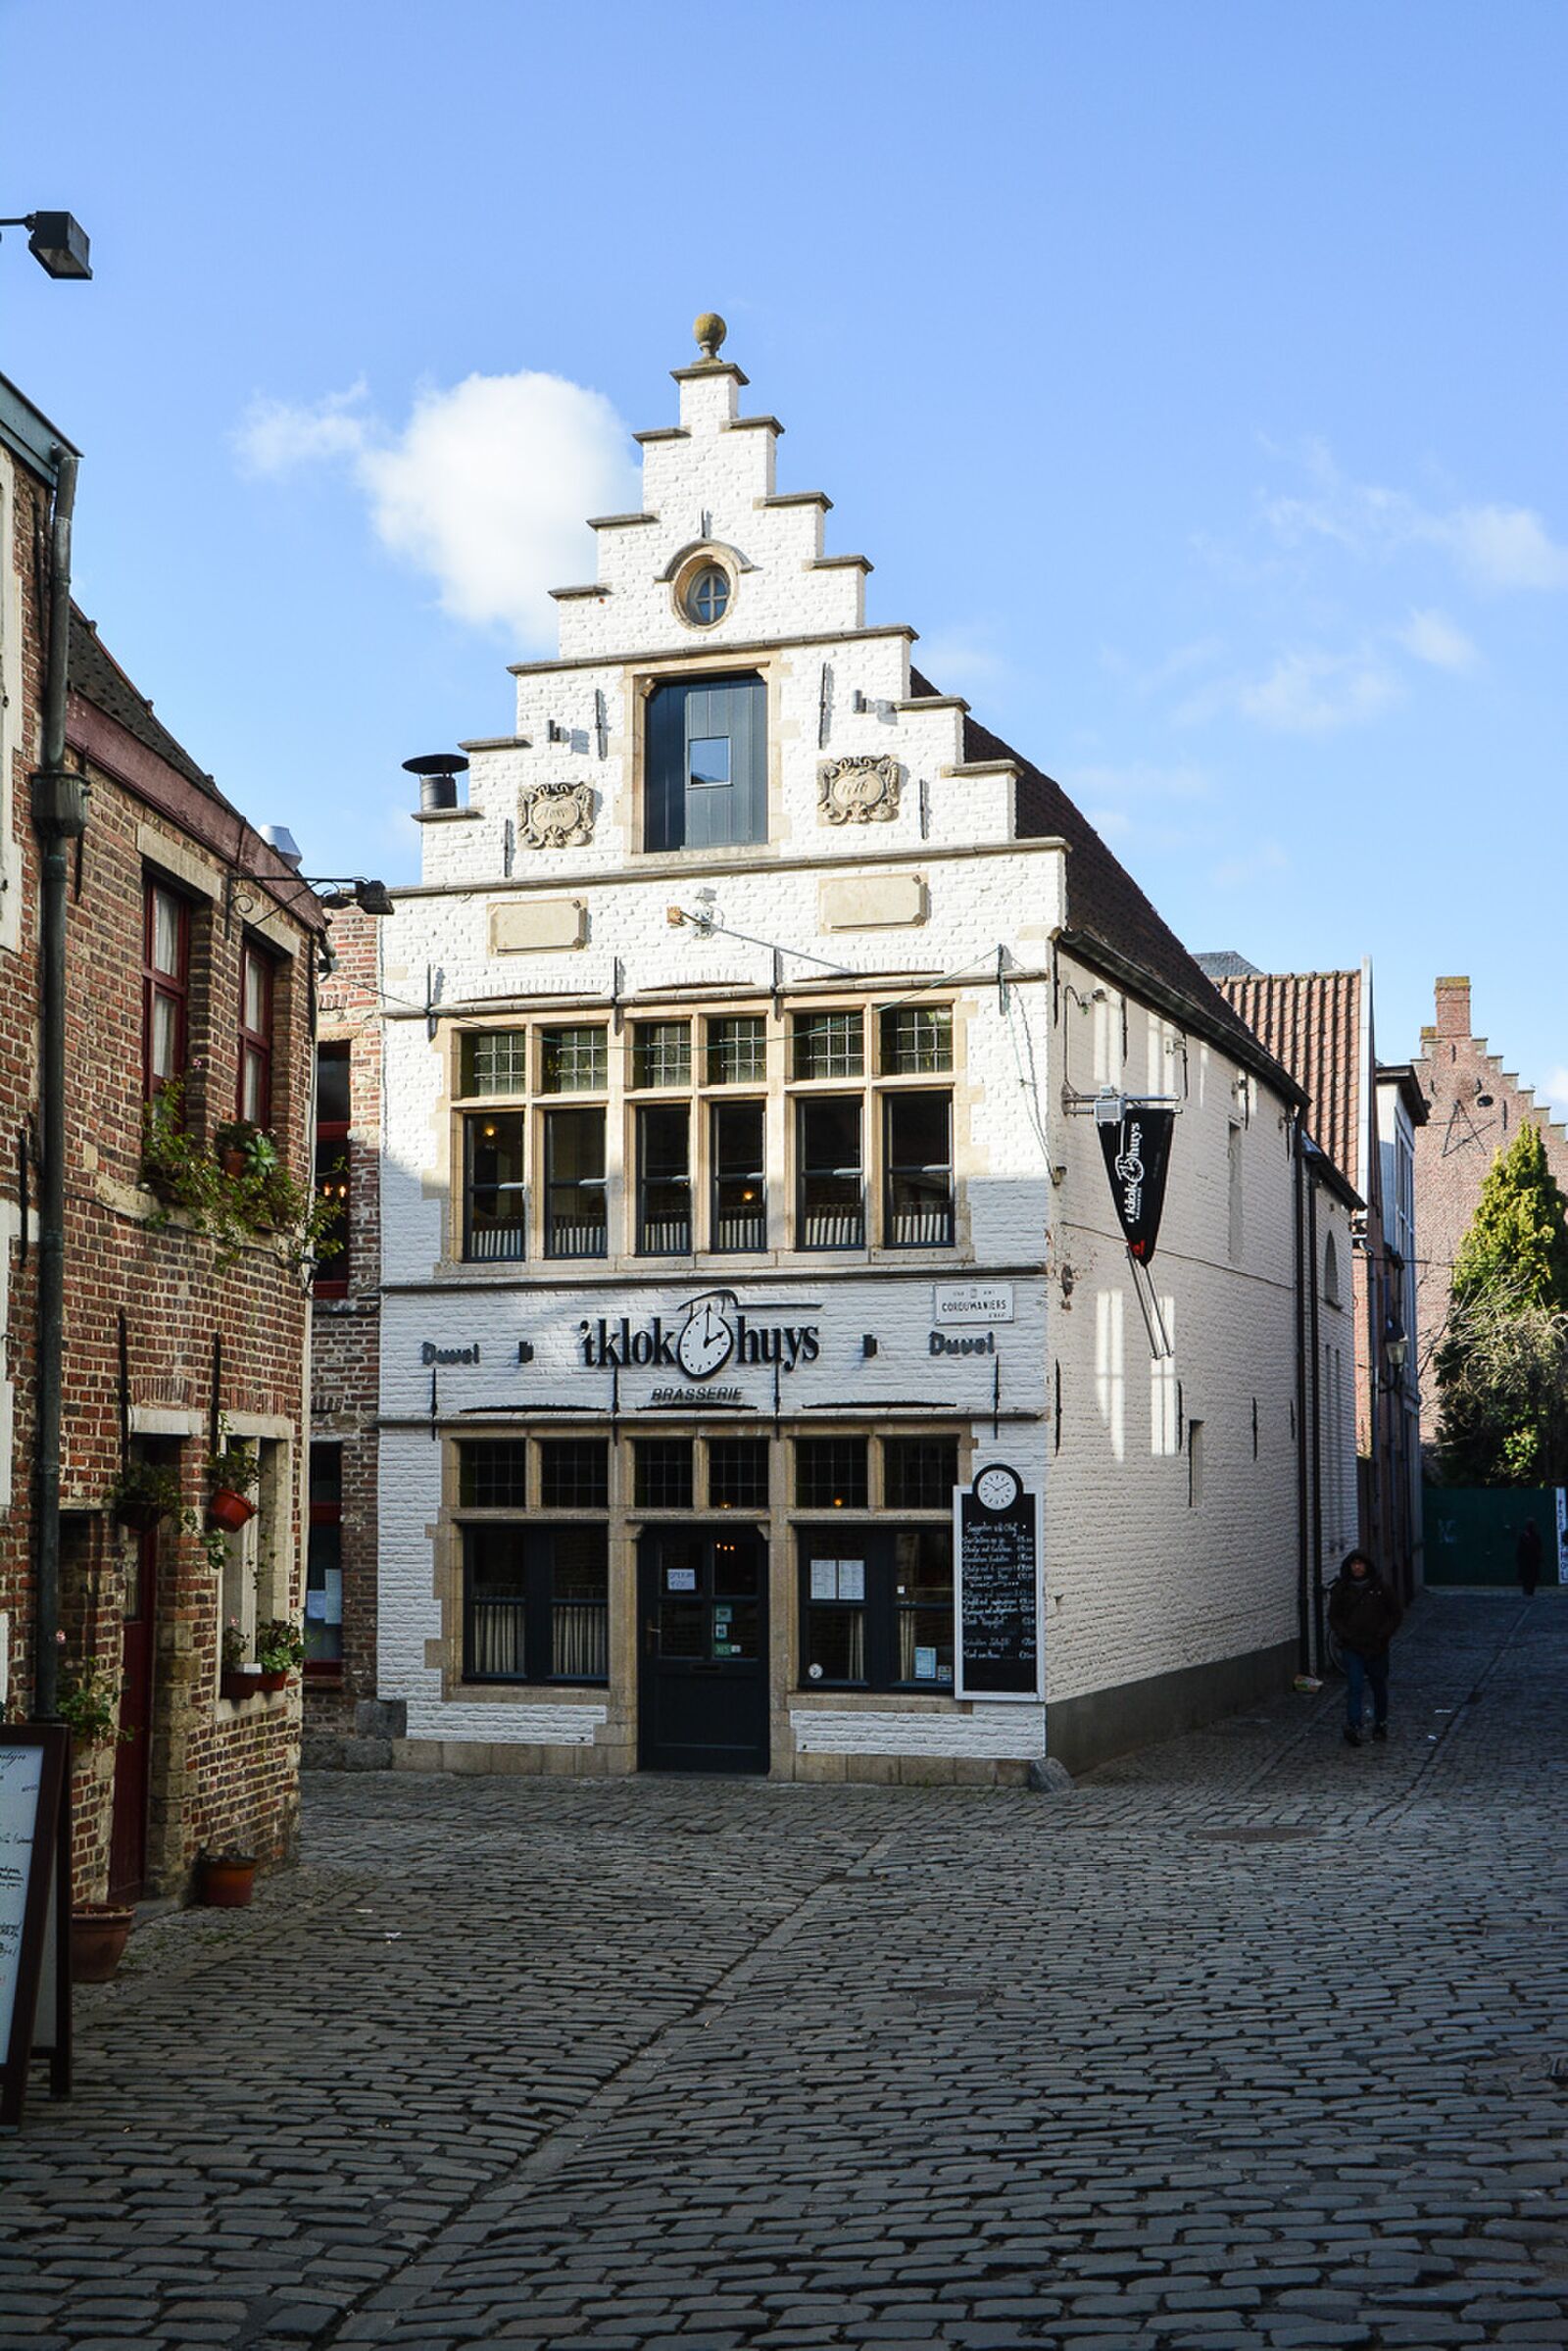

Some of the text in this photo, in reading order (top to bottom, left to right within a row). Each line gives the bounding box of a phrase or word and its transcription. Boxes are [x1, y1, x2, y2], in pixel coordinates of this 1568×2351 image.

[421, 1342, 480, 1365] Duvel
[736, 1315, 820, 1371] huys
[929, 1331, 995, 1356] Duvel
[651, 1388, 743, 1401] BRASSERIE
